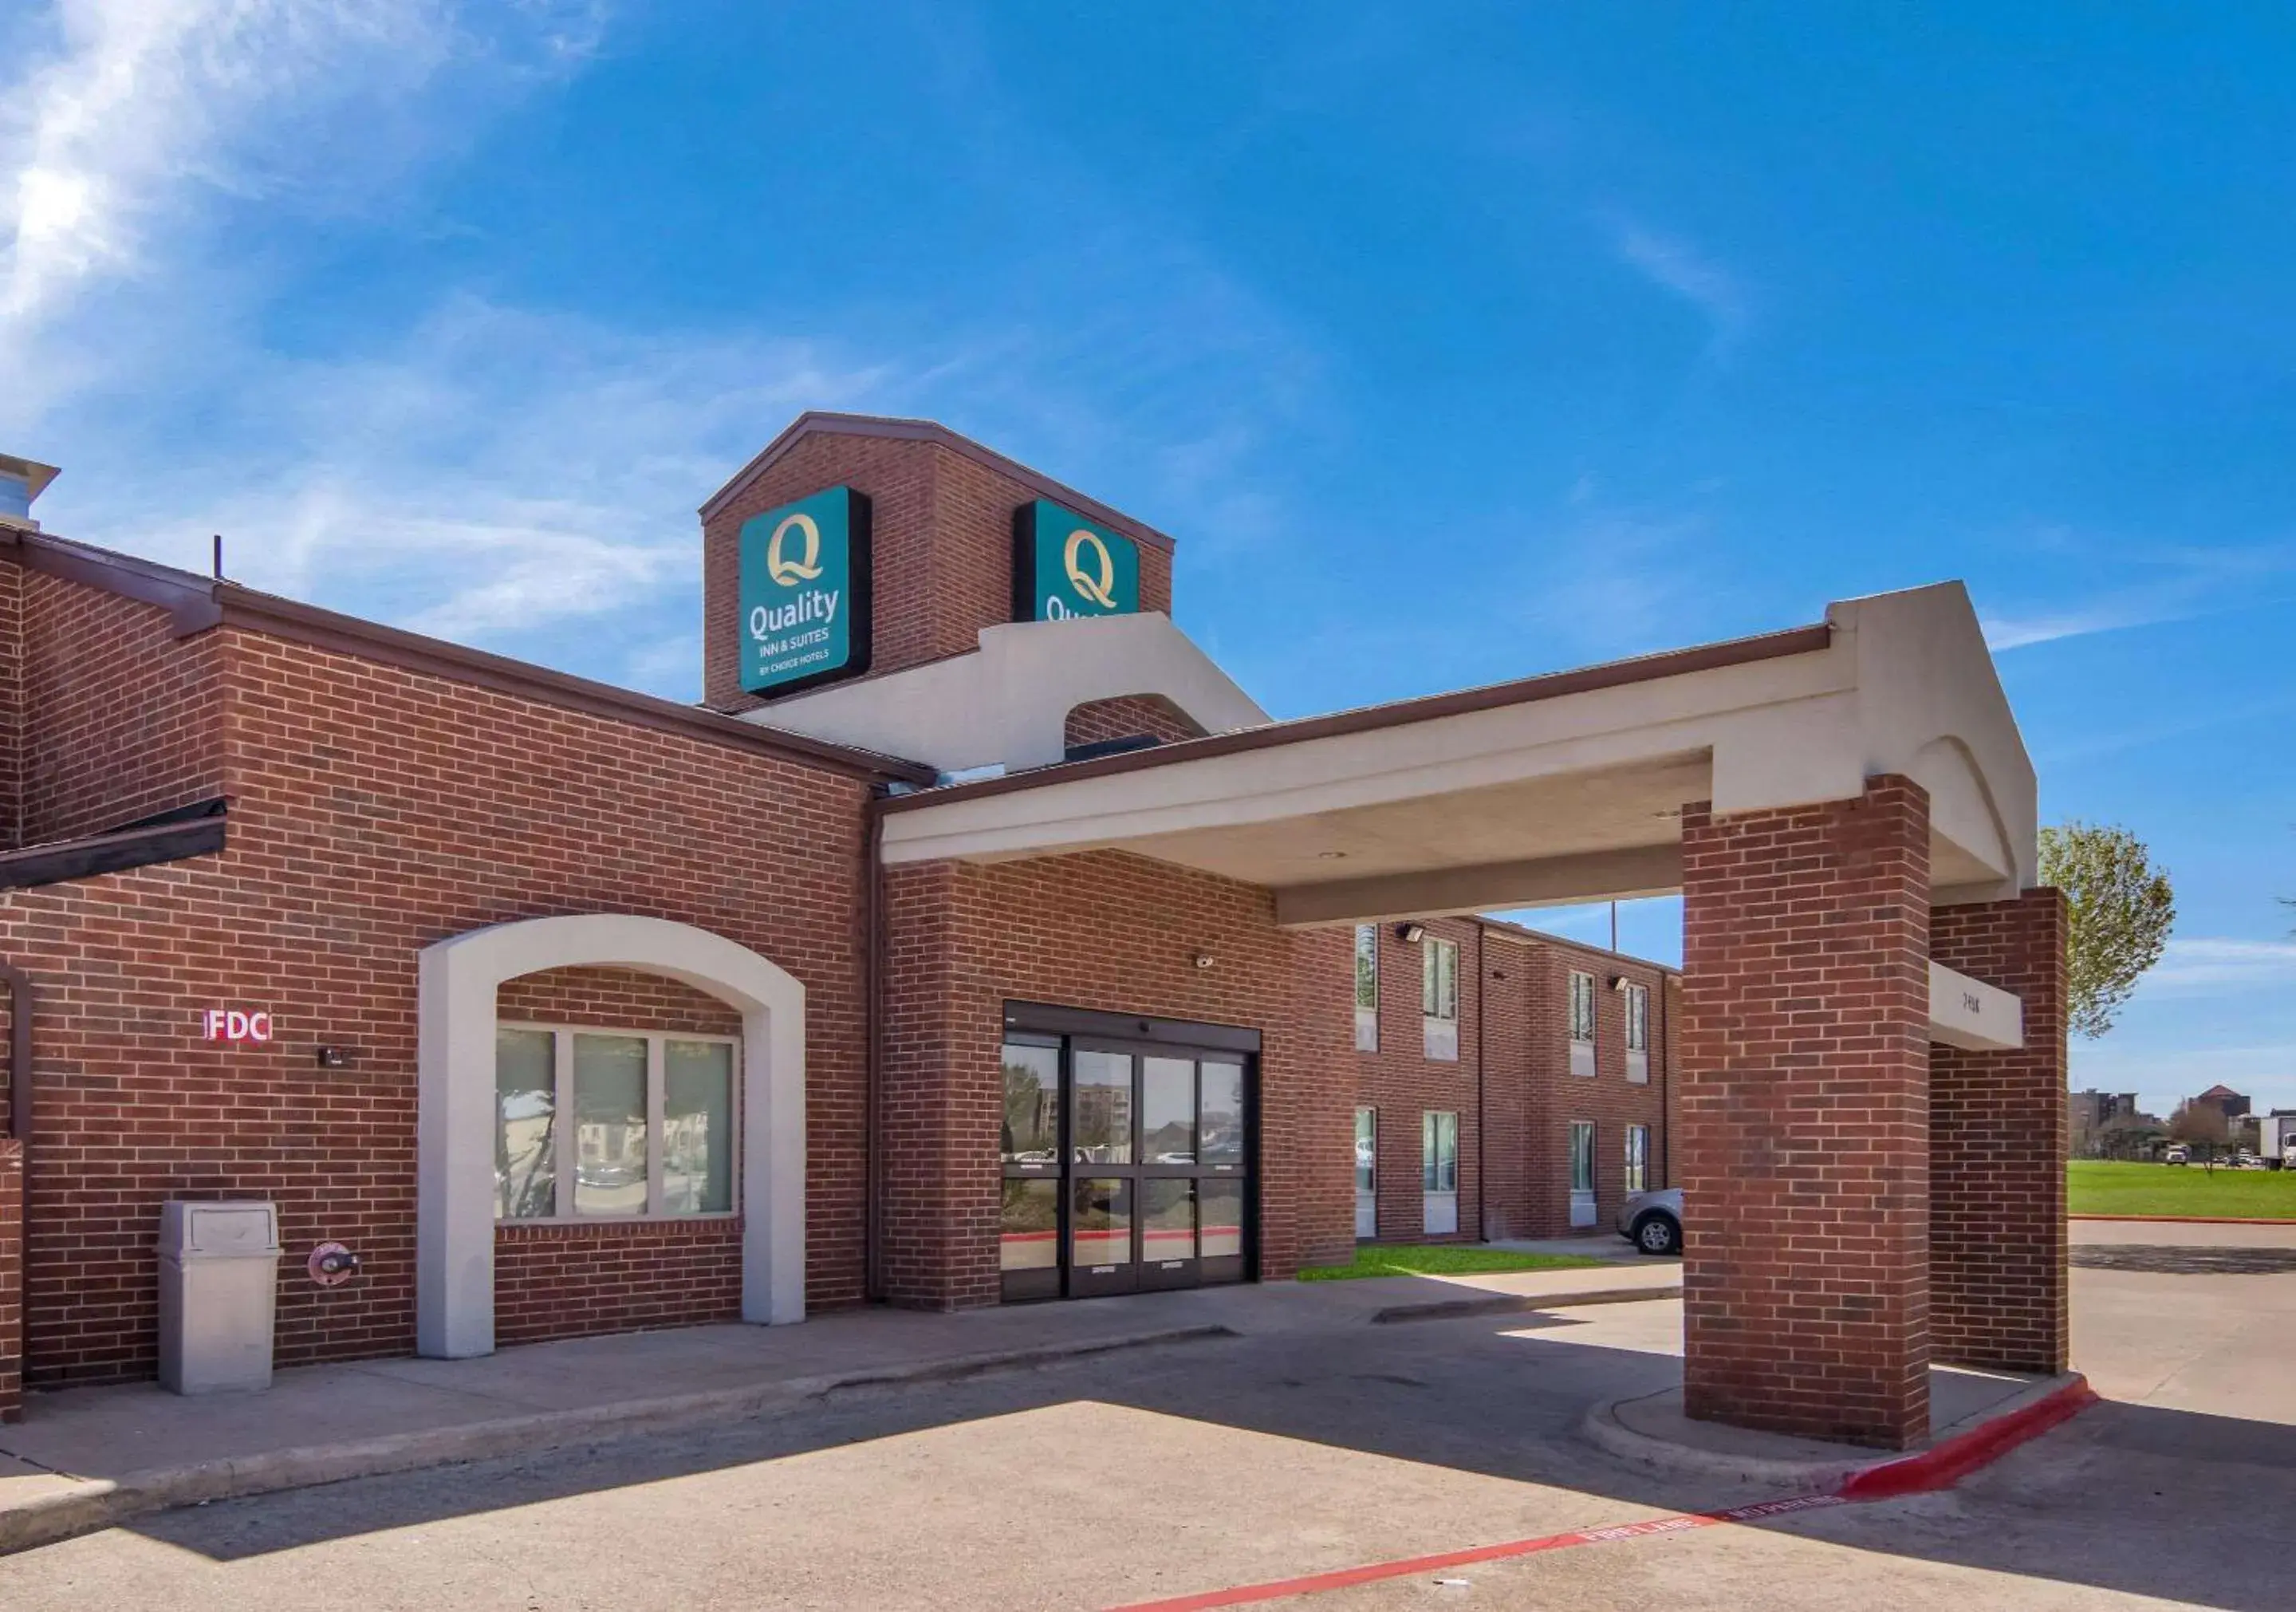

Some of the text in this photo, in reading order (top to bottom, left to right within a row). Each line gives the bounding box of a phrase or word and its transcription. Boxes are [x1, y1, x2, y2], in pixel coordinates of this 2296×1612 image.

[768, 514, 823, 586] Q
[1065, 530, 1116, 608] Q
[750, 589, 839, 641] Quality
[759, 626, 830, 658] INN & SUITES
[799, 648, 830, 666] HOTELS
[208, 1009, 268, 1041] FDC
